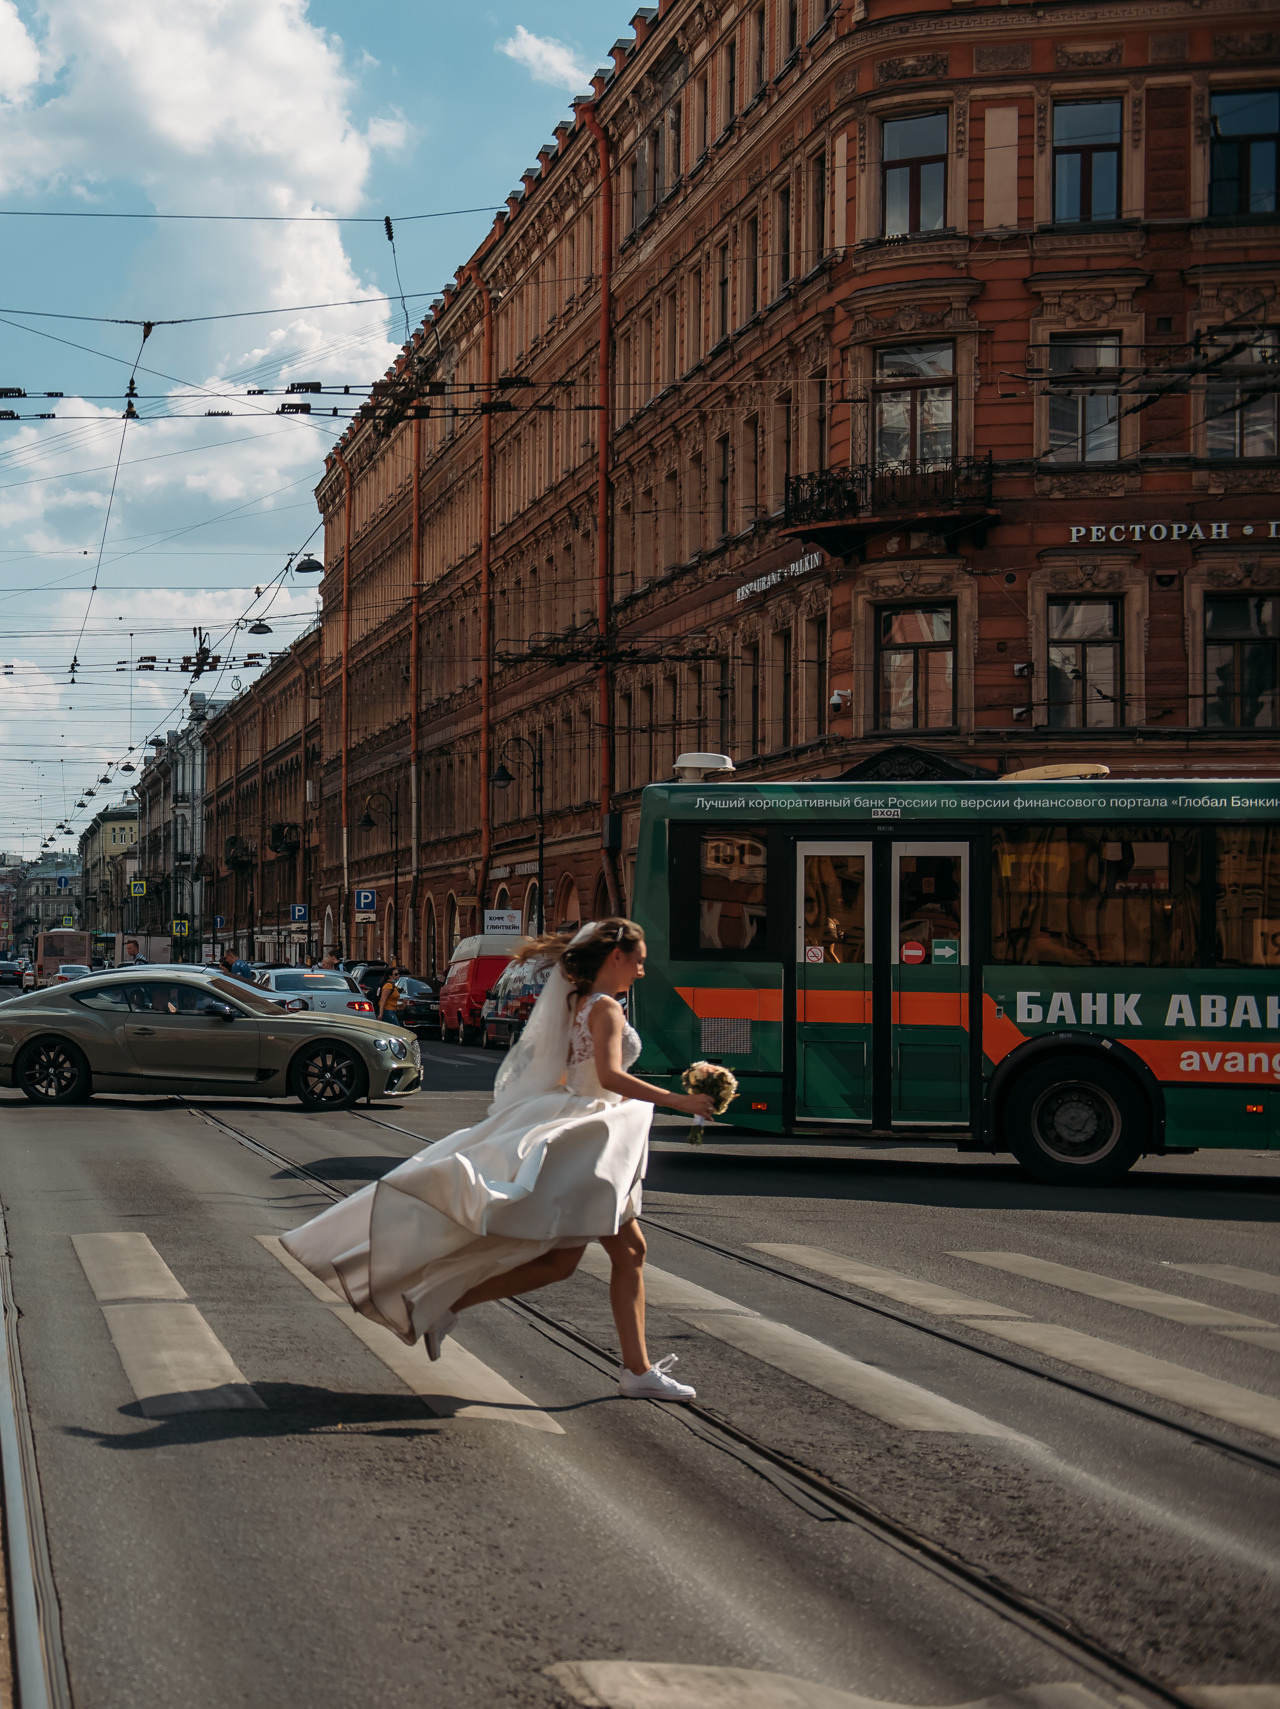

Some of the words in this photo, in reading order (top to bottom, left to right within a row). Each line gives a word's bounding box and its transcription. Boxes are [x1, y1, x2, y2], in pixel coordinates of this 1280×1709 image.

[1069, 522, 1230, 543] РЕСТОРАН
[790, 551, 820, 576] PALKIN
[694, 797, 746, 811] Лучший
[748, 797, 851, 810] корпоративный
[853, 796, 885, 808] банк
[888, 796, 937, 808] России
[940, 799, 958, 808] по
[960, 799, 1009, 810] версии
[1013, 796, 1107, 810] финансового
[1109, 798, 1168, 809] портала
[1171, 795, 1228, 807] «Глобал
[872, 809, 900, 818] ВХОД
[1016, 991, 1142, 1026] БАНК
